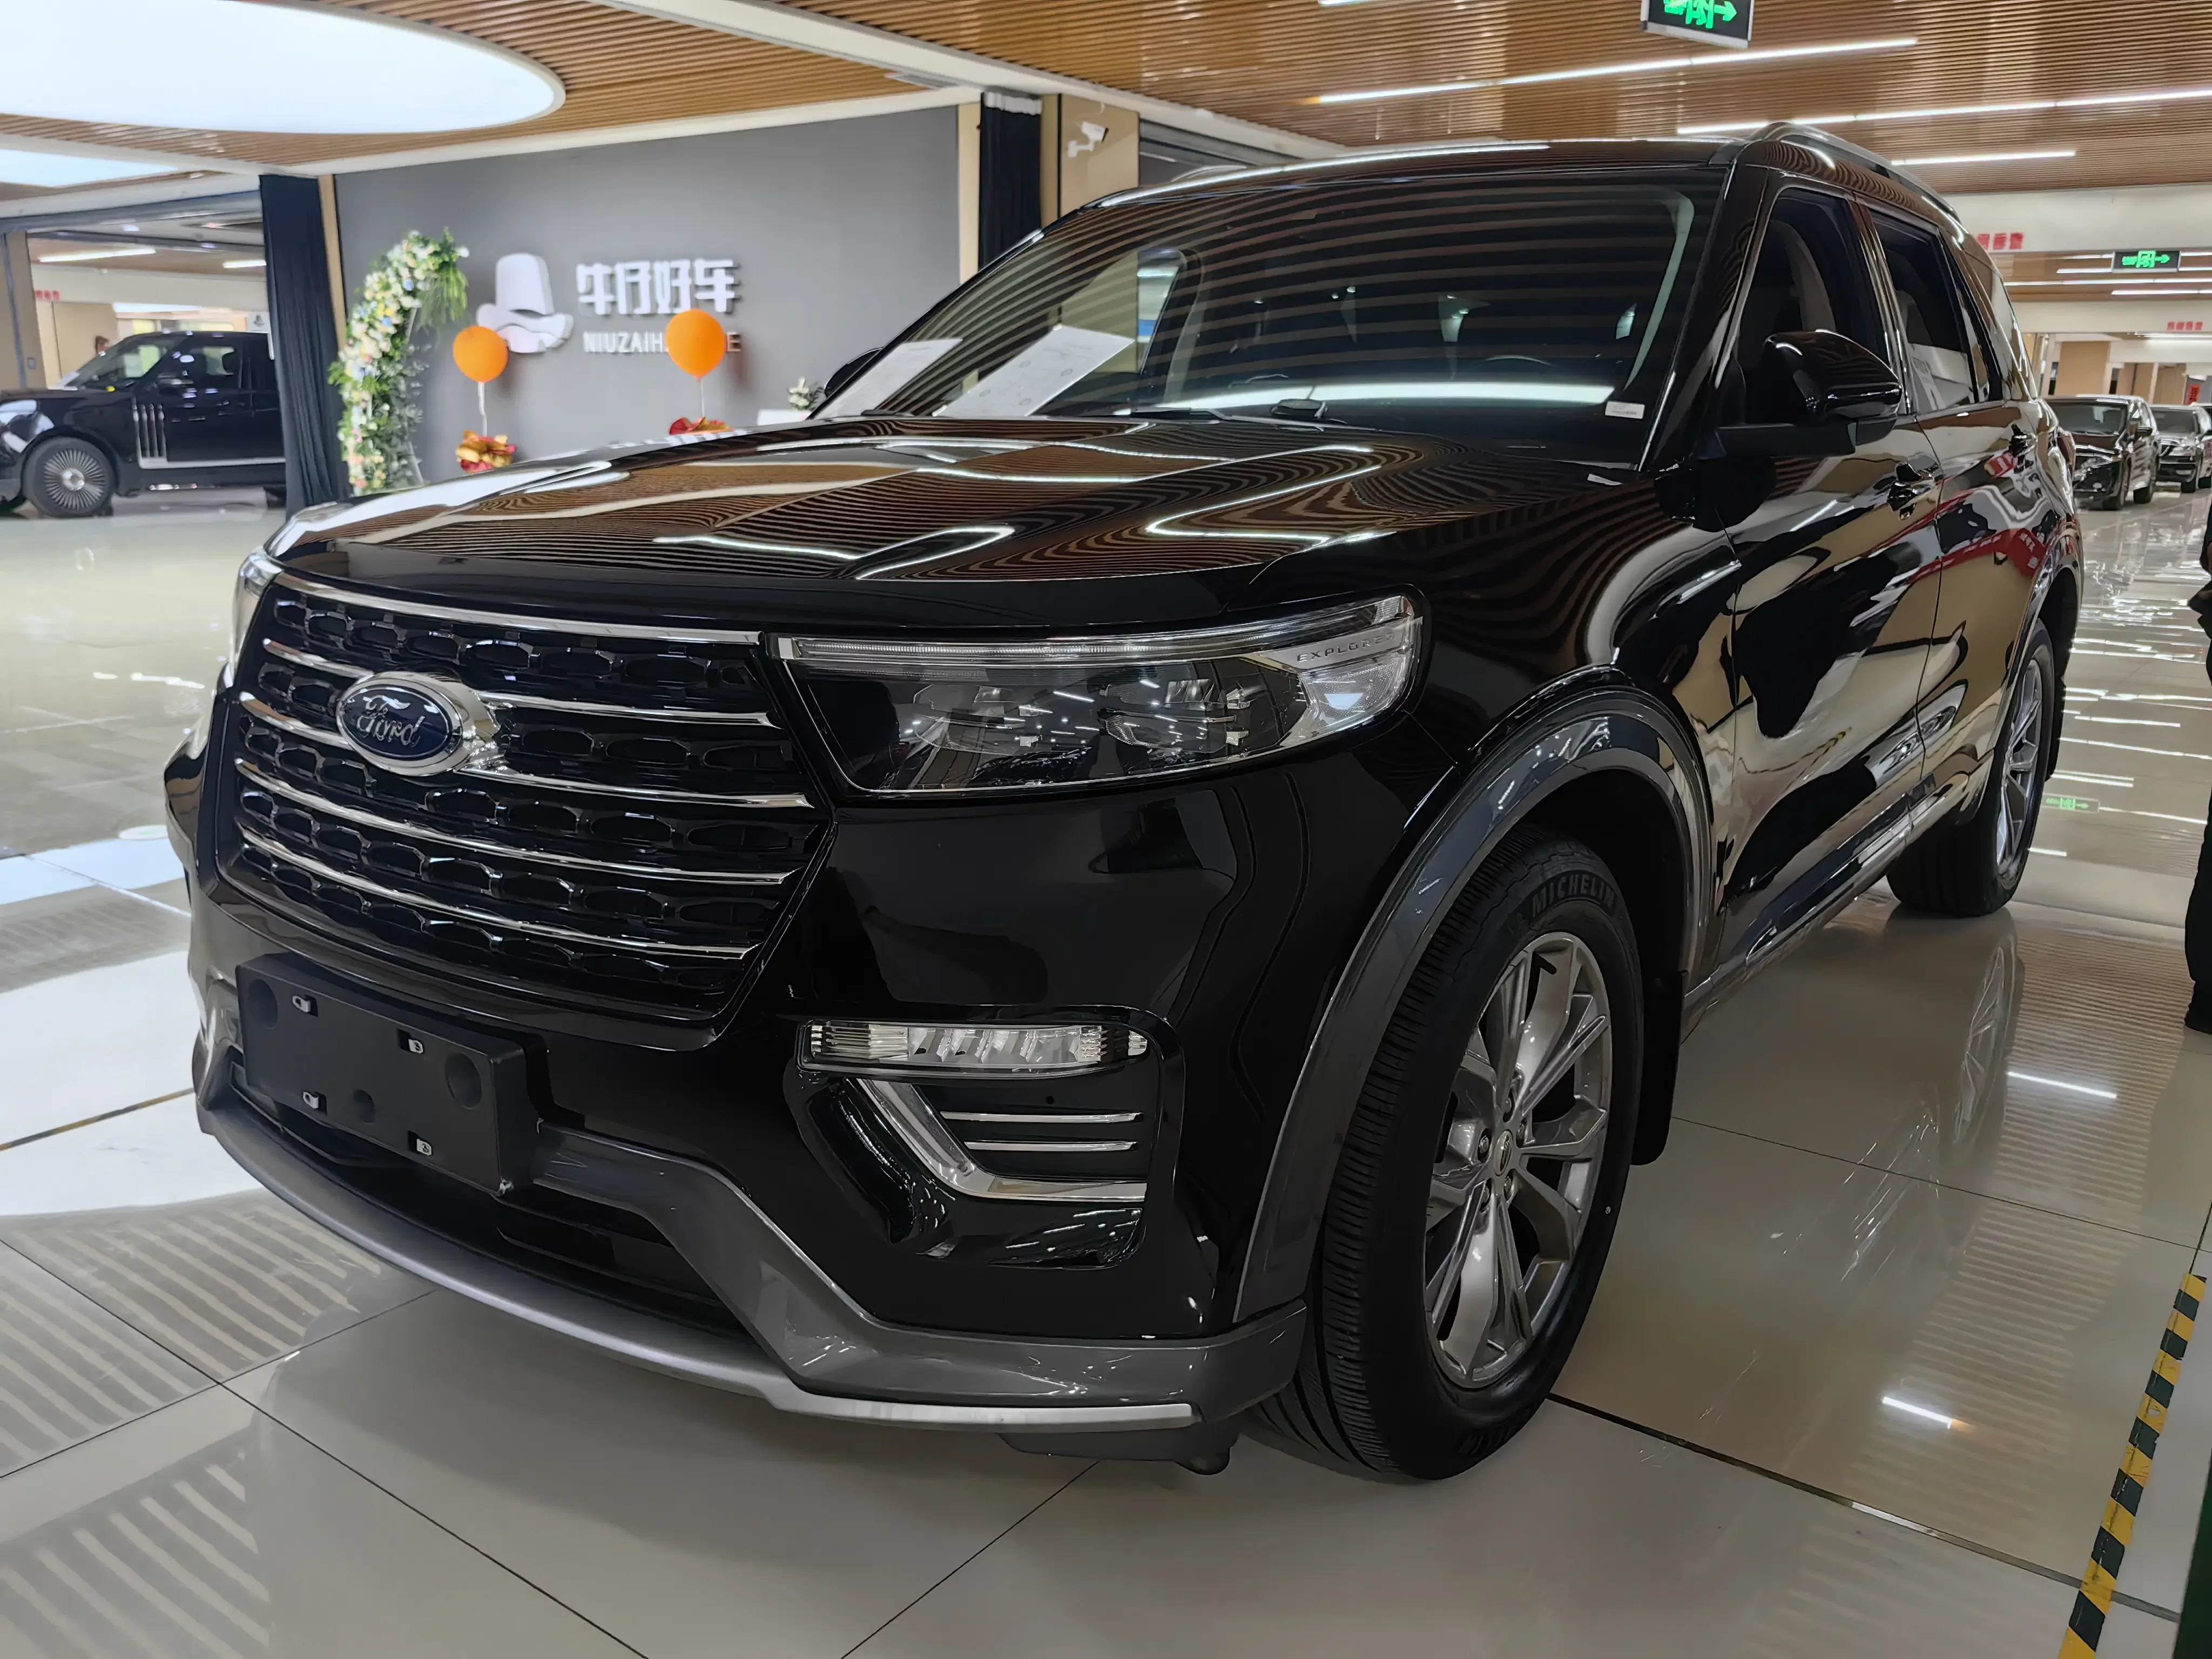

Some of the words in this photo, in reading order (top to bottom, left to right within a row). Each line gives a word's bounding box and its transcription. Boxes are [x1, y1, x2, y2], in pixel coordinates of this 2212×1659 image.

[583, 331, 742, 353] NIUZAIHE
[1297, 633, 1394, 662] EXPLORER
[356, 694, 426, 747] Ford
[1533, 873, 1615, 916] MICHELIN
